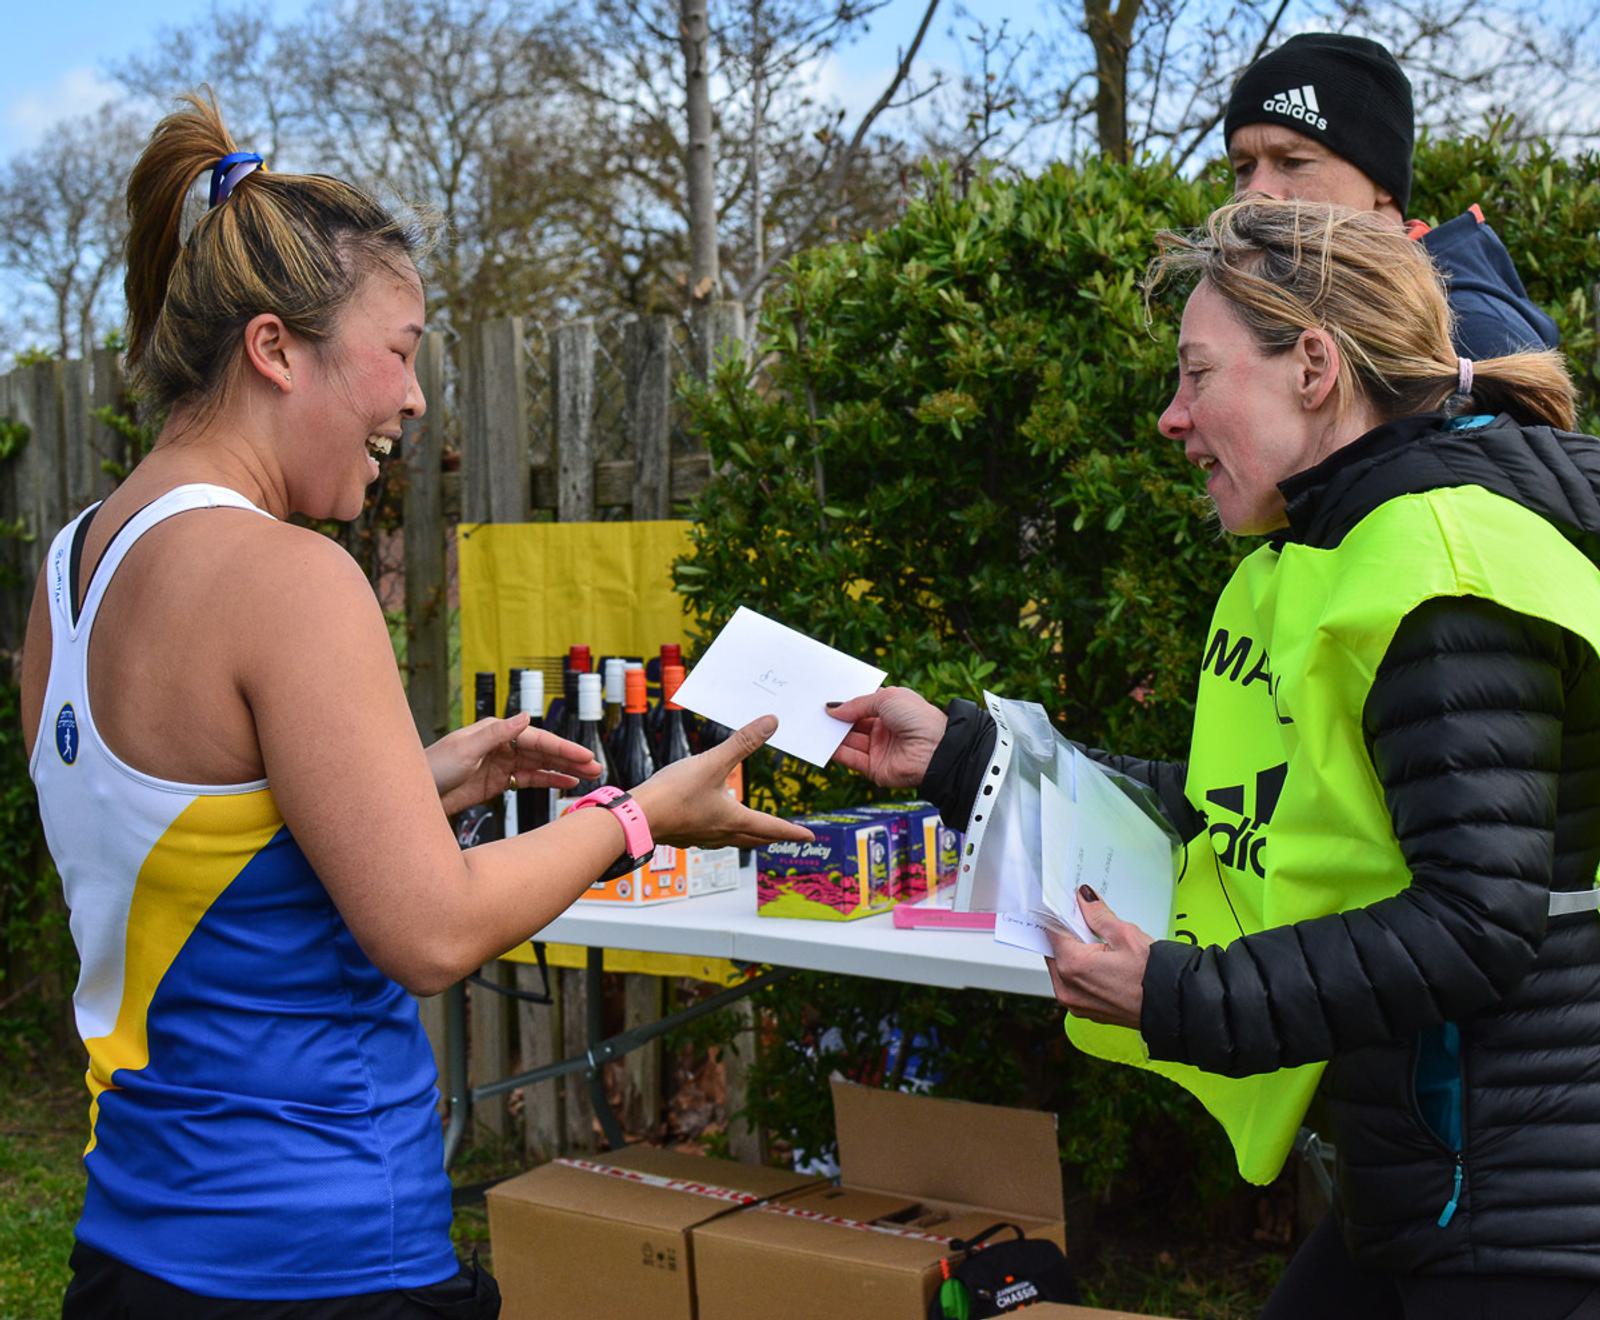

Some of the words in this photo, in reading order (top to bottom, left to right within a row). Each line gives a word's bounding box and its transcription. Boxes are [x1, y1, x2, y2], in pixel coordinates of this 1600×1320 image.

[1263, 99, 1328, 131] adidas
[767, 842, 801, 858] Boldly
[801, 843, 832, 860] Juicy
[996, 1285, 1038, 1308] CHASSIS
